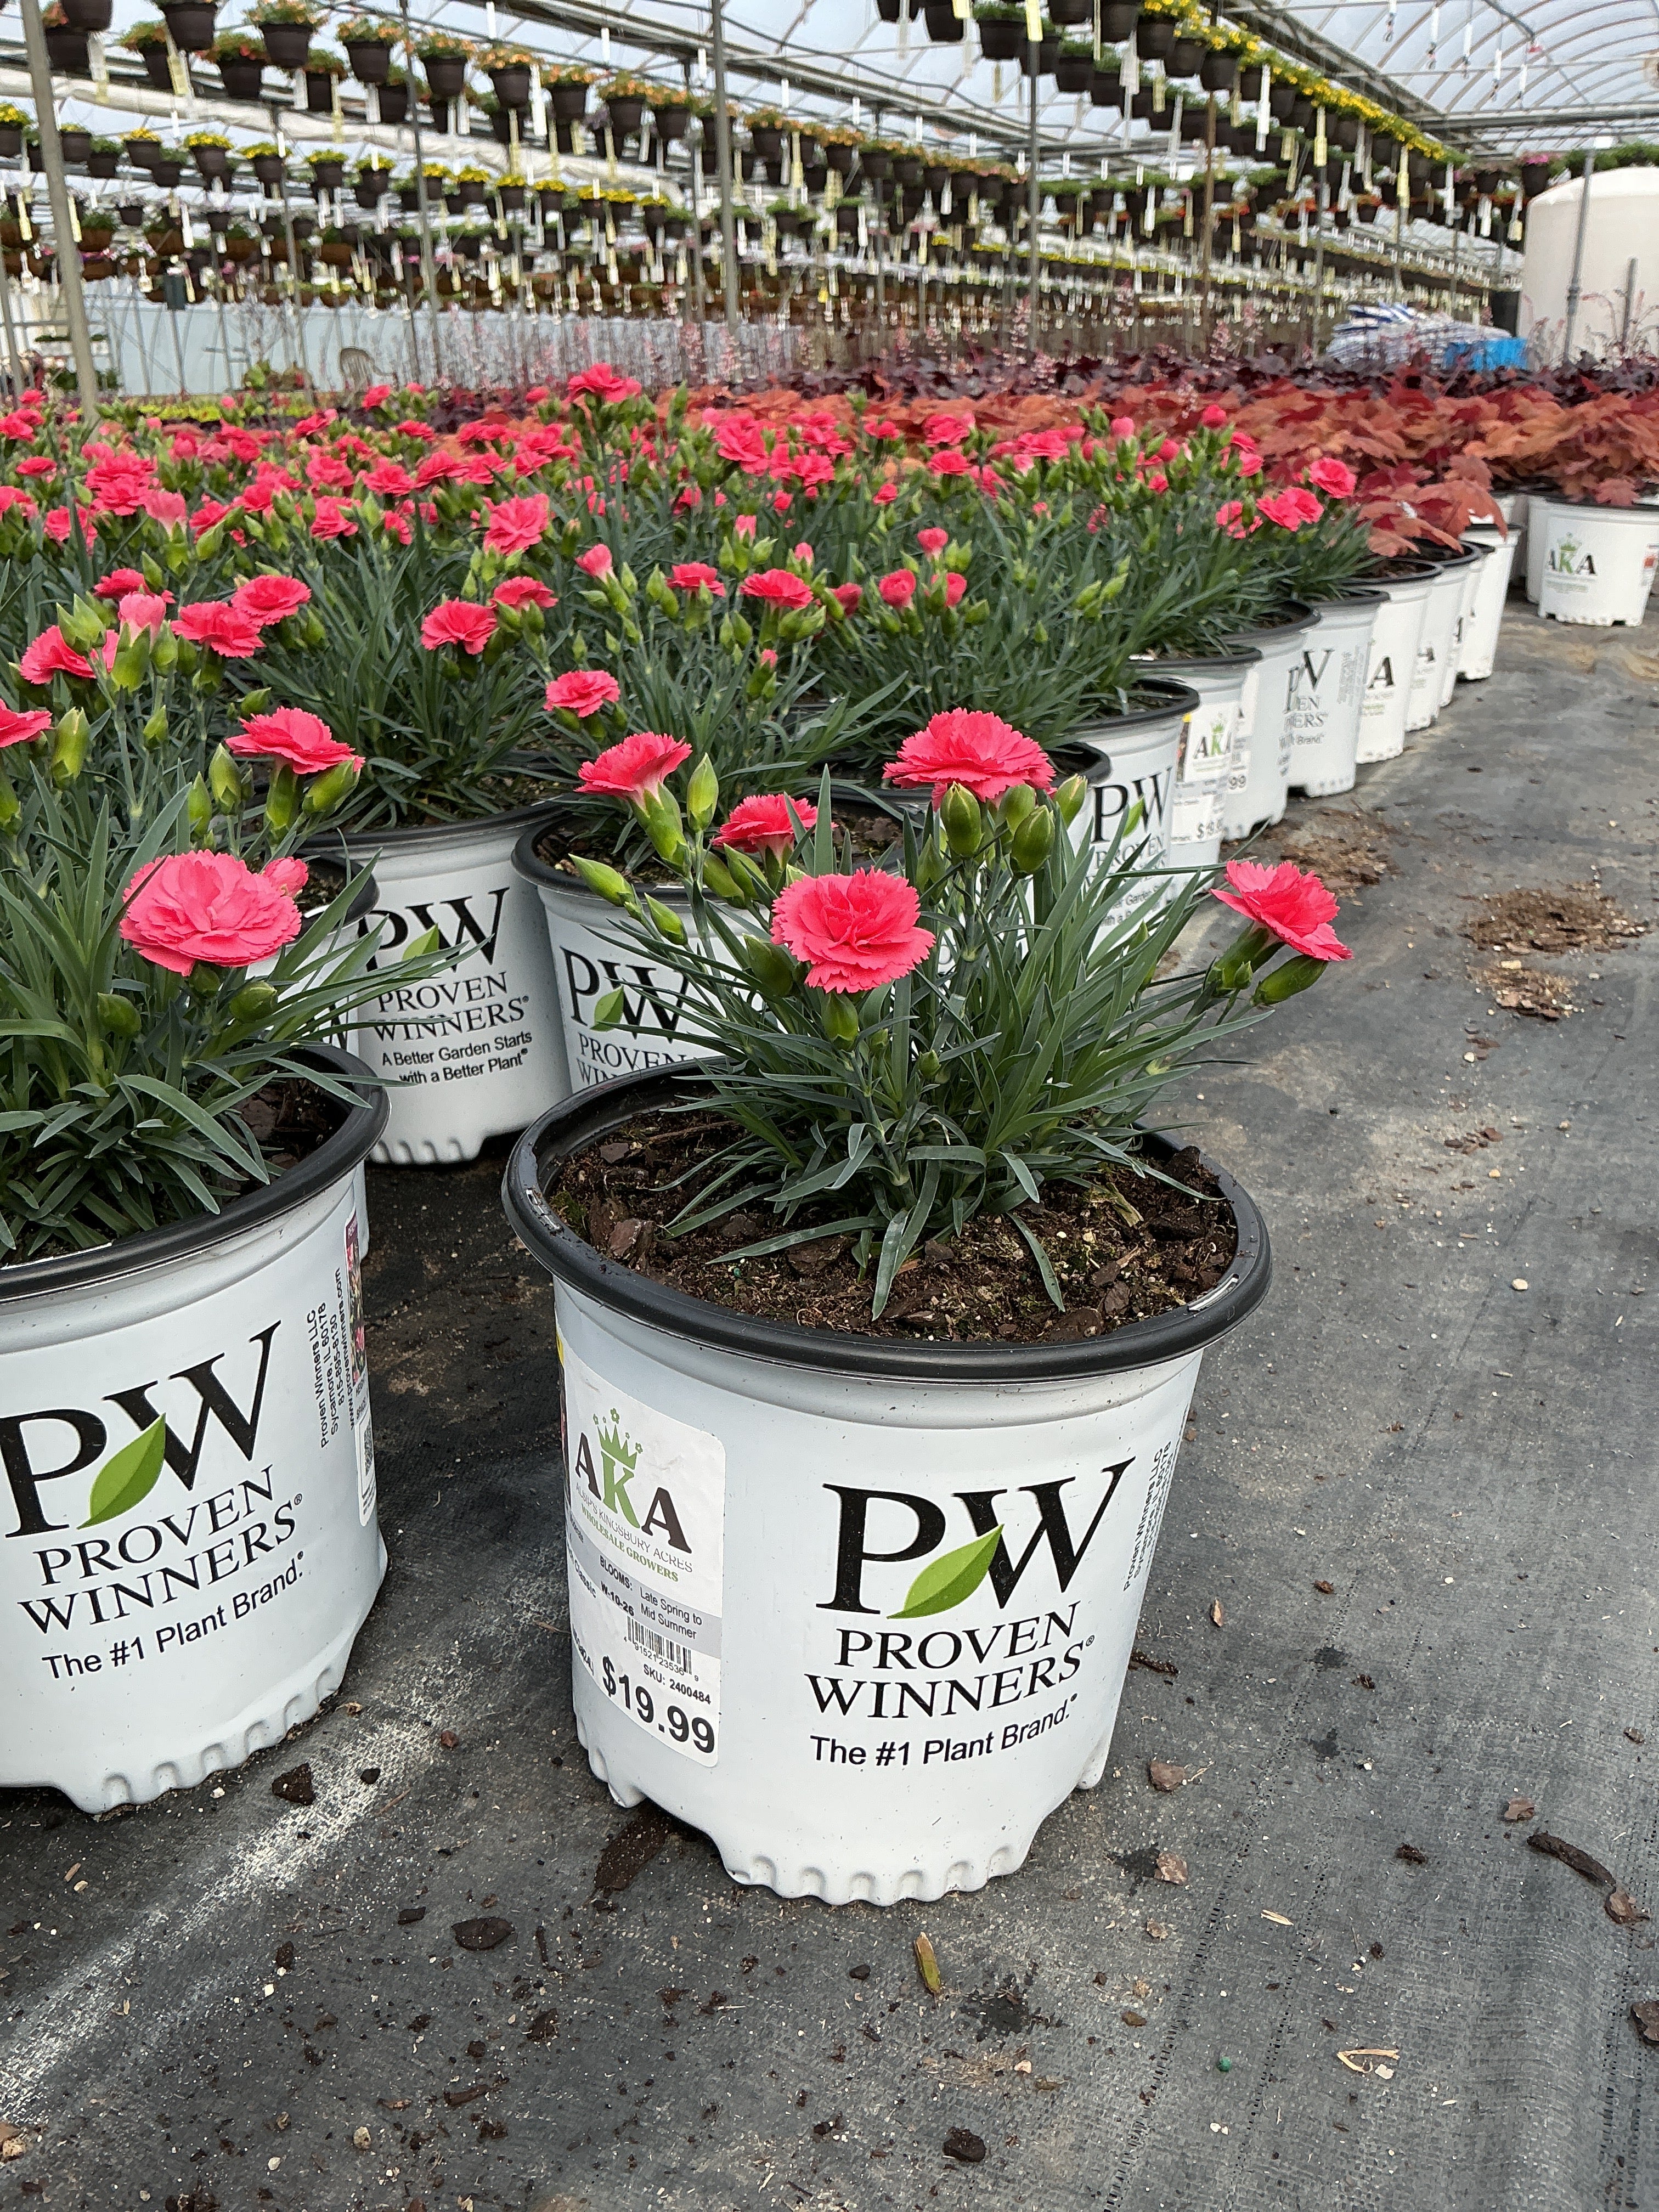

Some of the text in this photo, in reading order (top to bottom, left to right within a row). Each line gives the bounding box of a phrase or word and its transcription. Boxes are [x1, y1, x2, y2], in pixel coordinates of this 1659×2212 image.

[357, 887, 510, 973] PW
[369, 996, 525, 1041] WINNERS
[379, 972, 507, 1013] PROVEN
[560, 946, 689, 1044] PW
[382, 1031, 532, 1066] A Better Garden Starts
[399, 1053, 524, 1085] with a Better Plant
[307, 1310, 329, 1448] Proven Winners LLC
[318, 1302, 339, 1436] Sycamore, IL 60178
[330, 1314, 345, 1407] 815-895-8130
[0, 1319, 281, 1537] PW
[33, 1464, 274, 1586] PROVEN
[575, 1432, 692, 1554] AKA
[576, 1482, 597, 1514] ALSIP'S
[599, 1509, 651, 1553] KINGSBURY
[653, 1547, 693, 1573] ACRES
[1123, 1541, 1142, 1592] Proven
[1149, 1448, 1163, 1481] LLC
[581, 1503, 625, 1553] WHOLESALE
[627, 1547, 679, 1582] GROWERS
[815, 1457, 1136, 1614] PW
[574, 1559, 596, 1599] Classic
[600, 1555, 702, 1626] BLOOMS: Late Spring to
[42, 1654, 102, 1679] The
[110, 1637, 145, 1667] #1
[156, 1606, 227, 1653] Plant
[641, 1603, 697, 1640] Mid Summer
[834, 1601, 1081, 1669] PROVEN
[602, 1655, 715, 1753] $19.99
[644, 1664, 712, 1705] SKU: 2400484
[810, 1735, 867, 1765] The
[876, 1742, 909, 1767] #1
[923, 1731, 994, 1764] Plant
